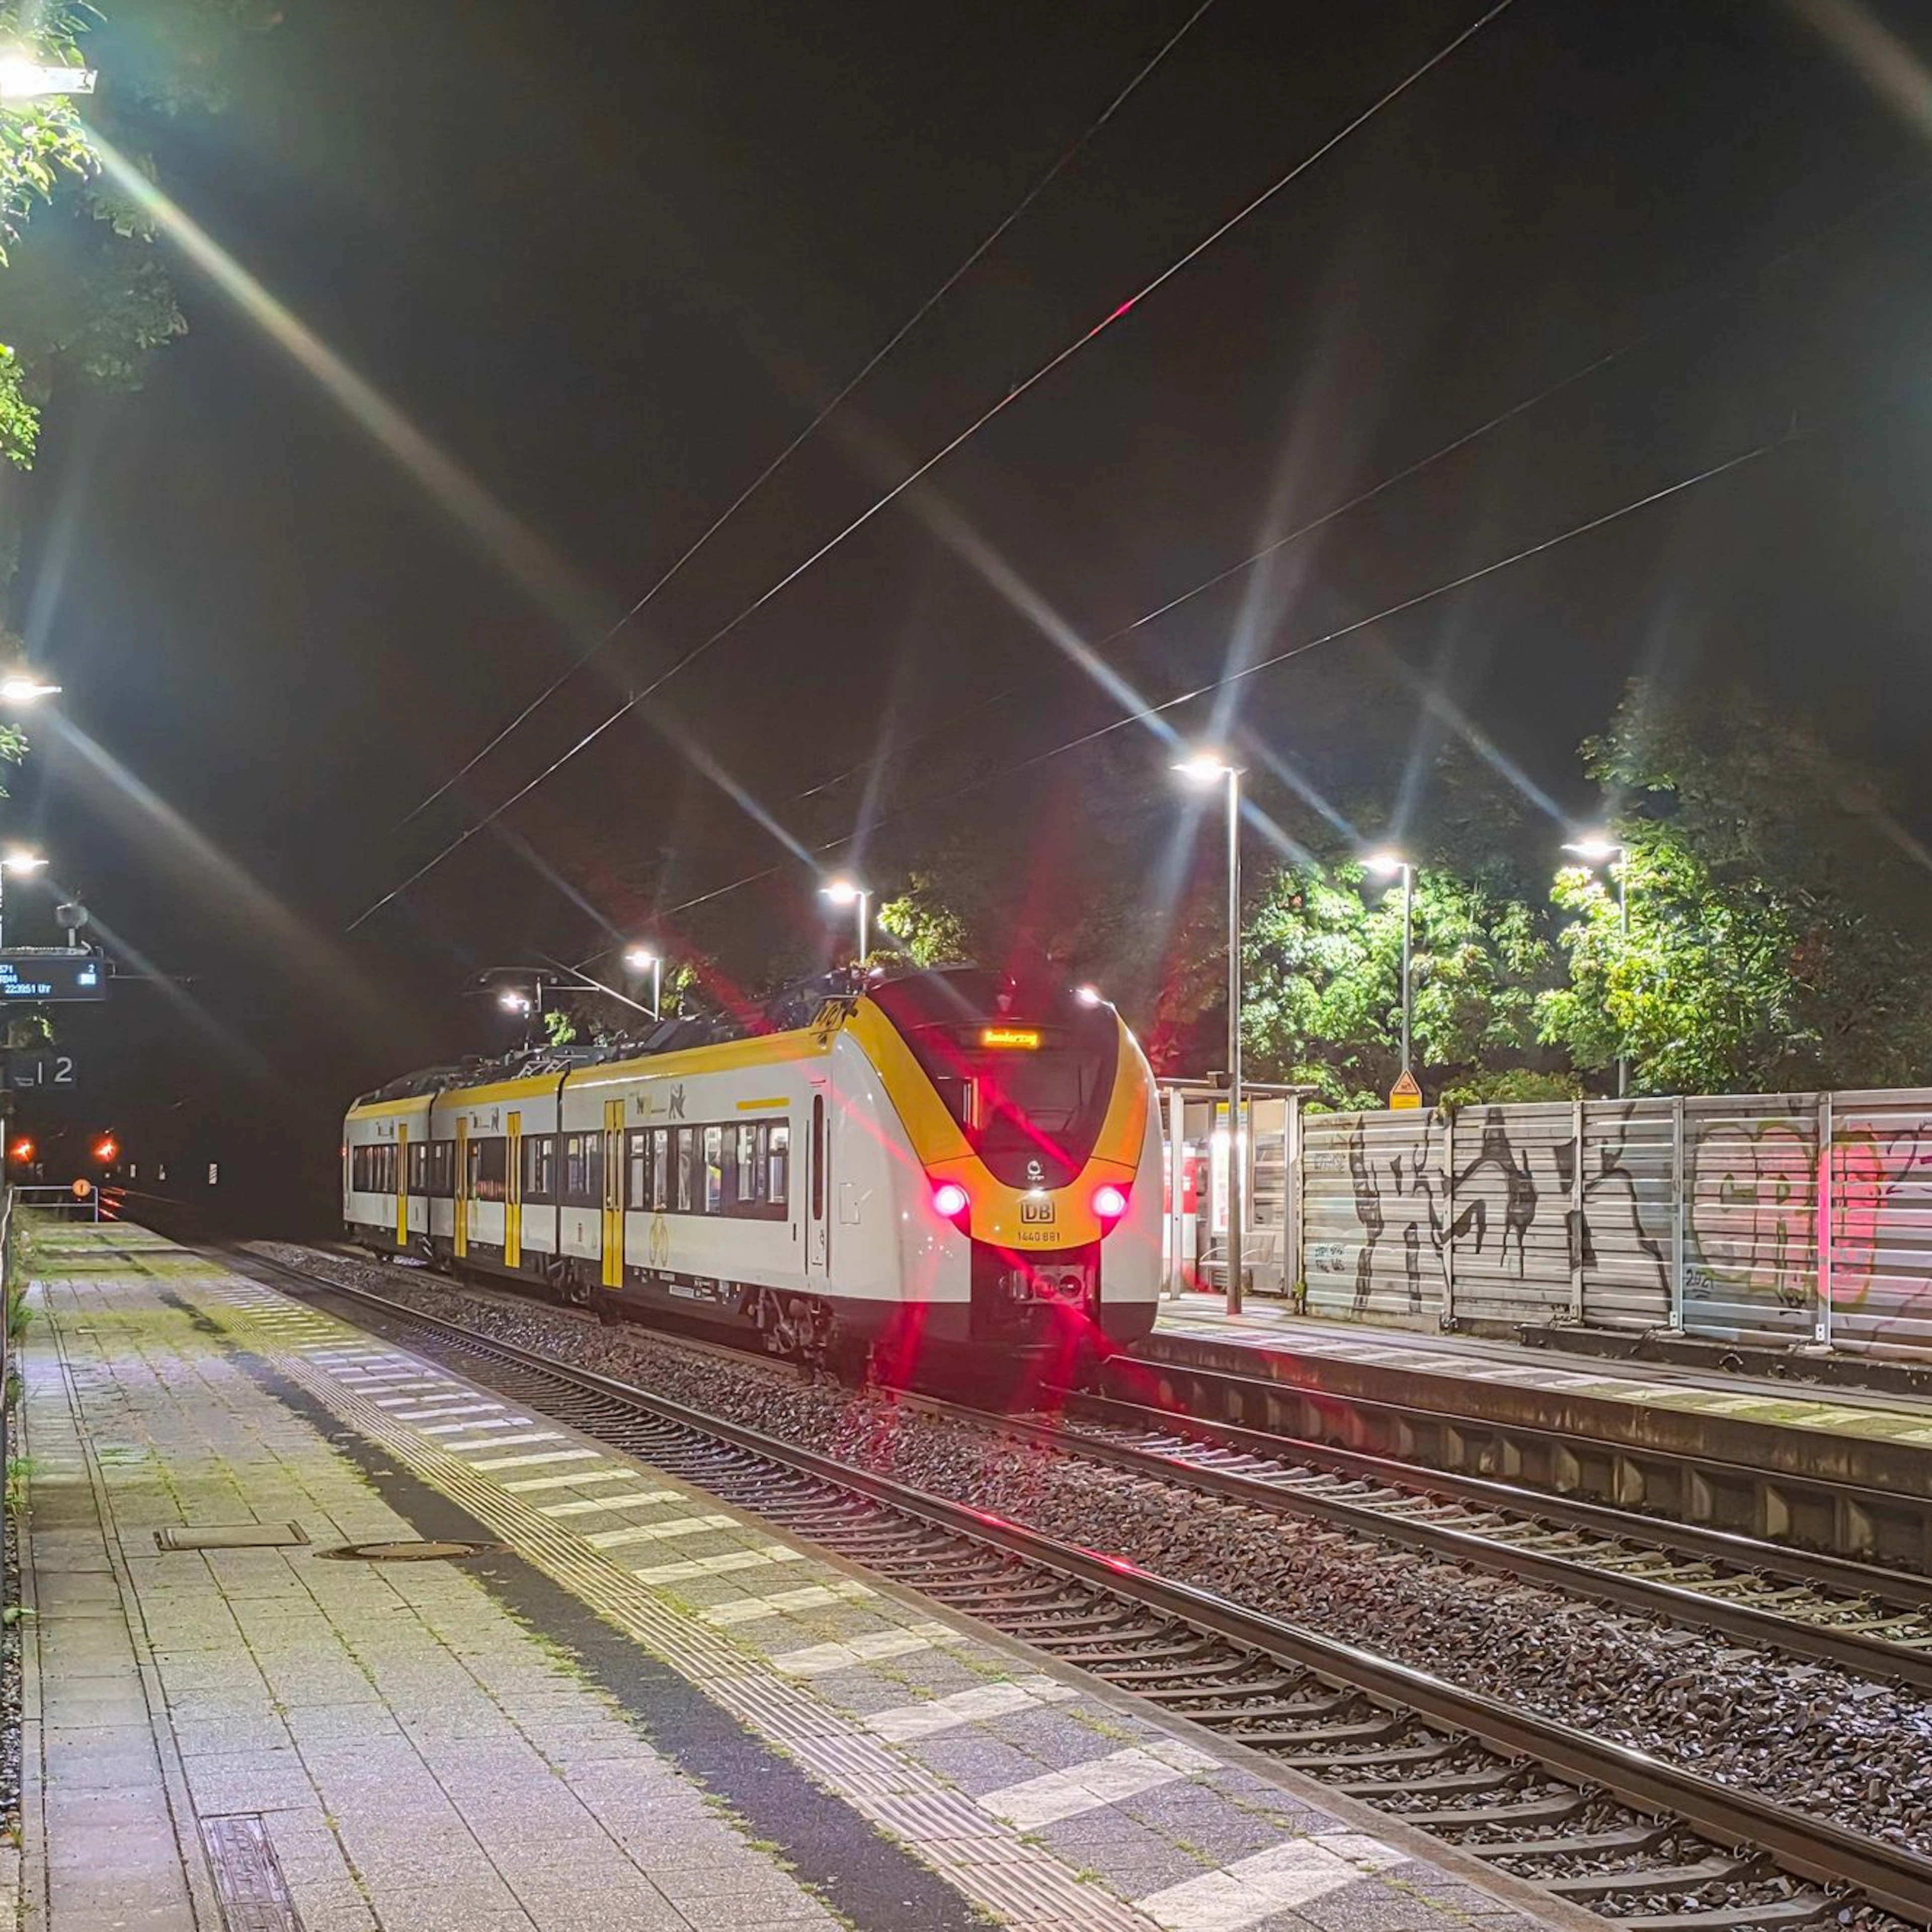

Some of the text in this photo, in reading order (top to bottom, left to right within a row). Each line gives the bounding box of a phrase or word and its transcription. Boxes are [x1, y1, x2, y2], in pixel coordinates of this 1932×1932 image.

[88, 963, 96, 973] 2
[54, 1057, 72, 1082] 2
[1026, 1203, 1051, 1220] DB
[1018, 1232, 1040, 1242] 1440
